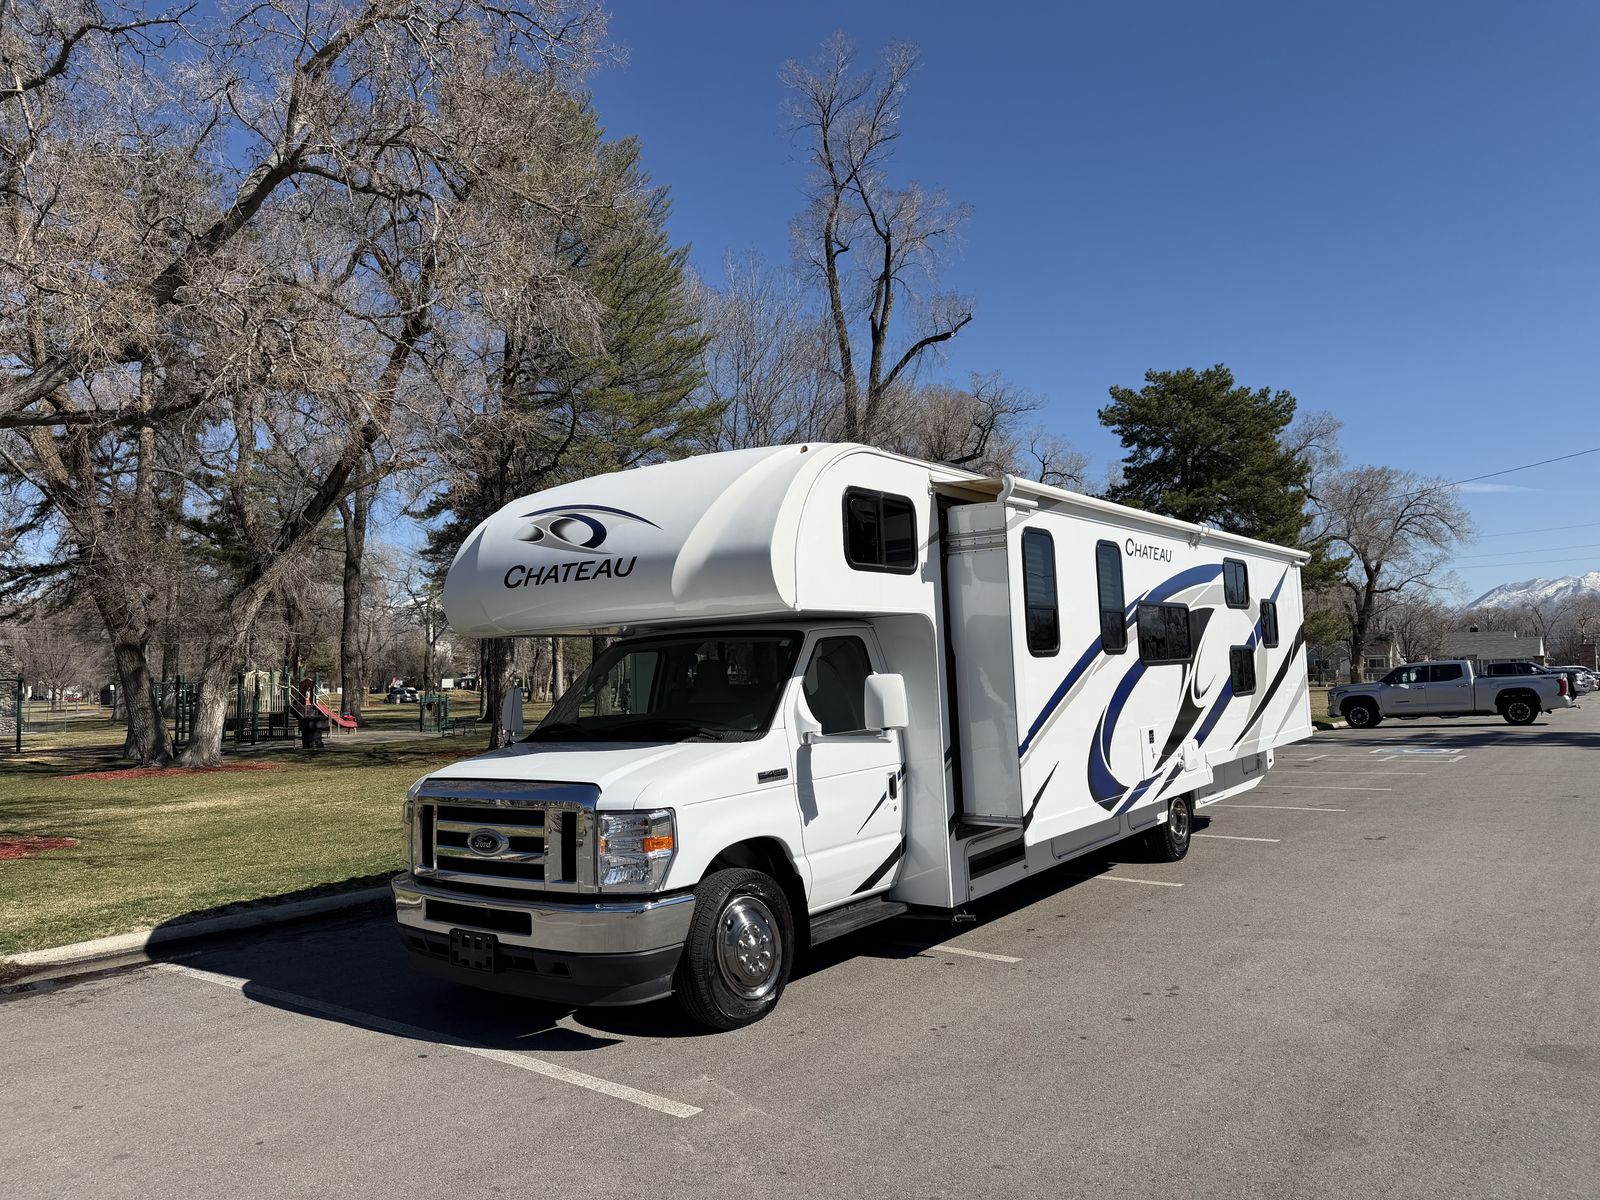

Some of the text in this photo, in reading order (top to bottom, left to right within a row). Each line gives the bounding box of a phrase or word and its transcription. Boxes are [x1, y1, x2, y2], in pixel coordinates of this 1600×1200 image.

[1125, 538, 1172, 563] CHATEAU
[504, 556, 637, 589] CHATEAU
[474, 836, 492, 848] Ford
